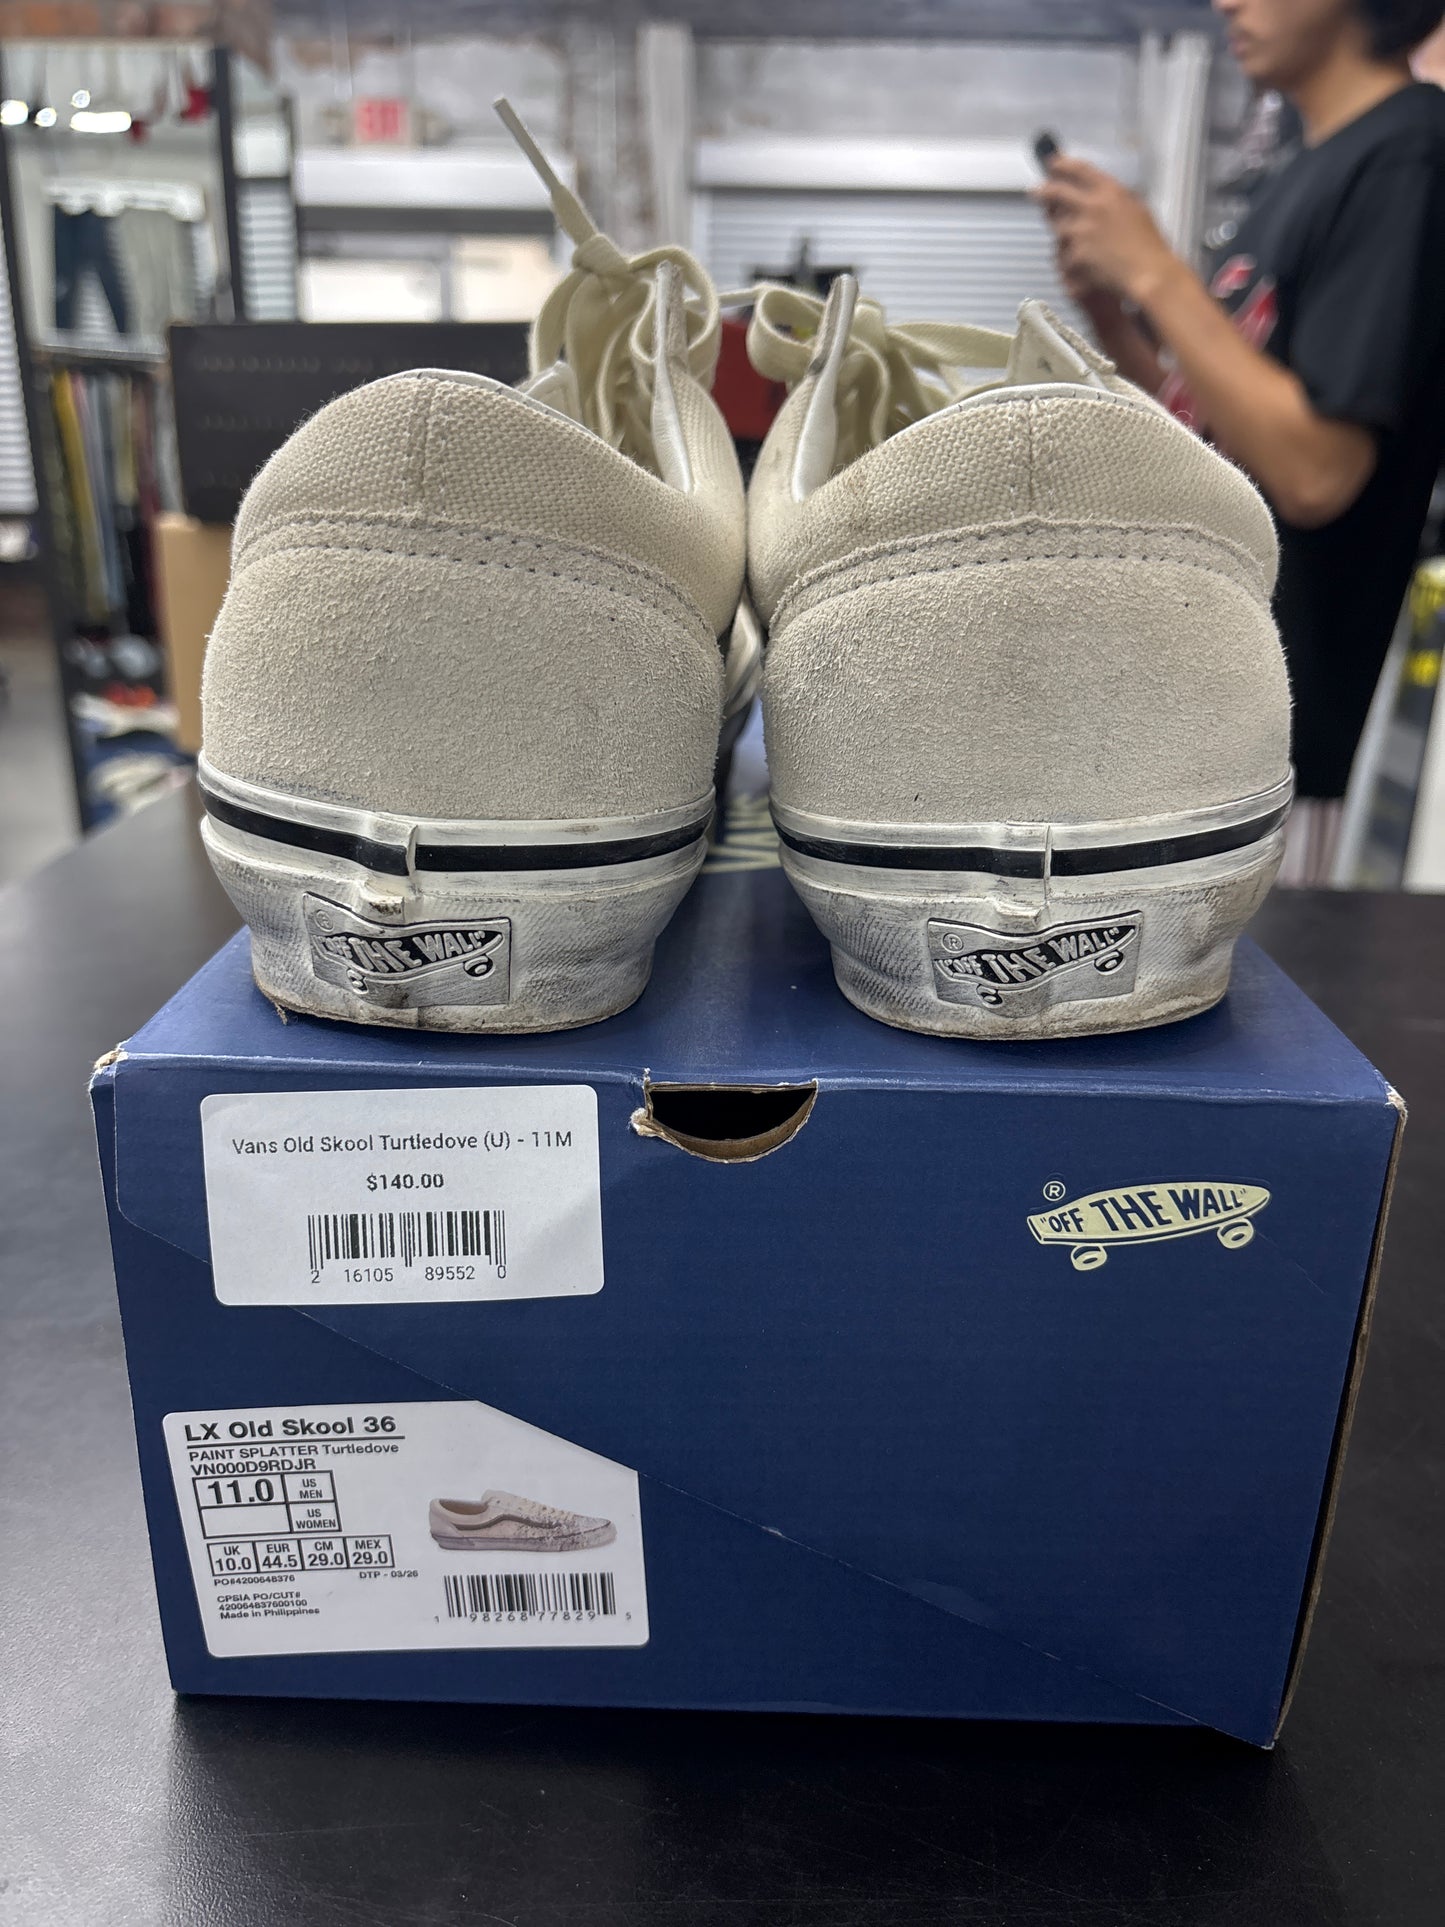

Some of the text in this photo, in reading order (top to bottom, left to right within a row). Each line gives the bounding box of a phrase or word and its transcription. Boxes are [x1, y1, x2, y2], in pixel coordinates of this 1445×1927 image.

[348, 937, 422, 973] THE
[981, 947, 1056, 982] THE
[233, 1138, 279, 1155] Vans
[283, 1135, 314, 1152] Old
[320, 1133, 374, 1151] Skool
[379, 1132, 478, 1150] Turtledove
[484, 1130, 511, 1151] (U)
[532, 1131, 572, 1148] 11M
[366, 1172, 445, 1191] $140.00
[1089, 1190, 1171, 1231] THE
[344, 1268, 394, 1283] 16105
[424, 1266, 476, 1281] 89552
[184, 1416, 396, 1442] LX Old Skool 36
[189, 1443, 399, 1462] PAINT SPLATTER Turtledove
[190, 1458, 316, 1476] VN000D9RDJR
[302, 1478, 317, 1488] US
[207, 1478, 275, 1504] 11.0
[299, 1489, 323, 1499] MEN
[307, 1508, 322, 1518] US
[296, 1519, 336, 1529] WOMEN
[223, 1546, 241, 1556] UK
[266, 1543, 290, 1553] EUR
[314, 1541, 333, 1551] CM
[355, 1539, 382, 1550] MEX
[215, 1556, 251, 1572] 10.0
[262, 1554, 298, 1569] 44.5
[308, 1553, 345, 1567] 29.0
[352, 1551, 389, 1565] 29.0
[359, 1571, 381, 1580] DTP
[216, 1594, 251, 1603] CPSIA
[219, 1607, 320, 1620] Made in Philippines
